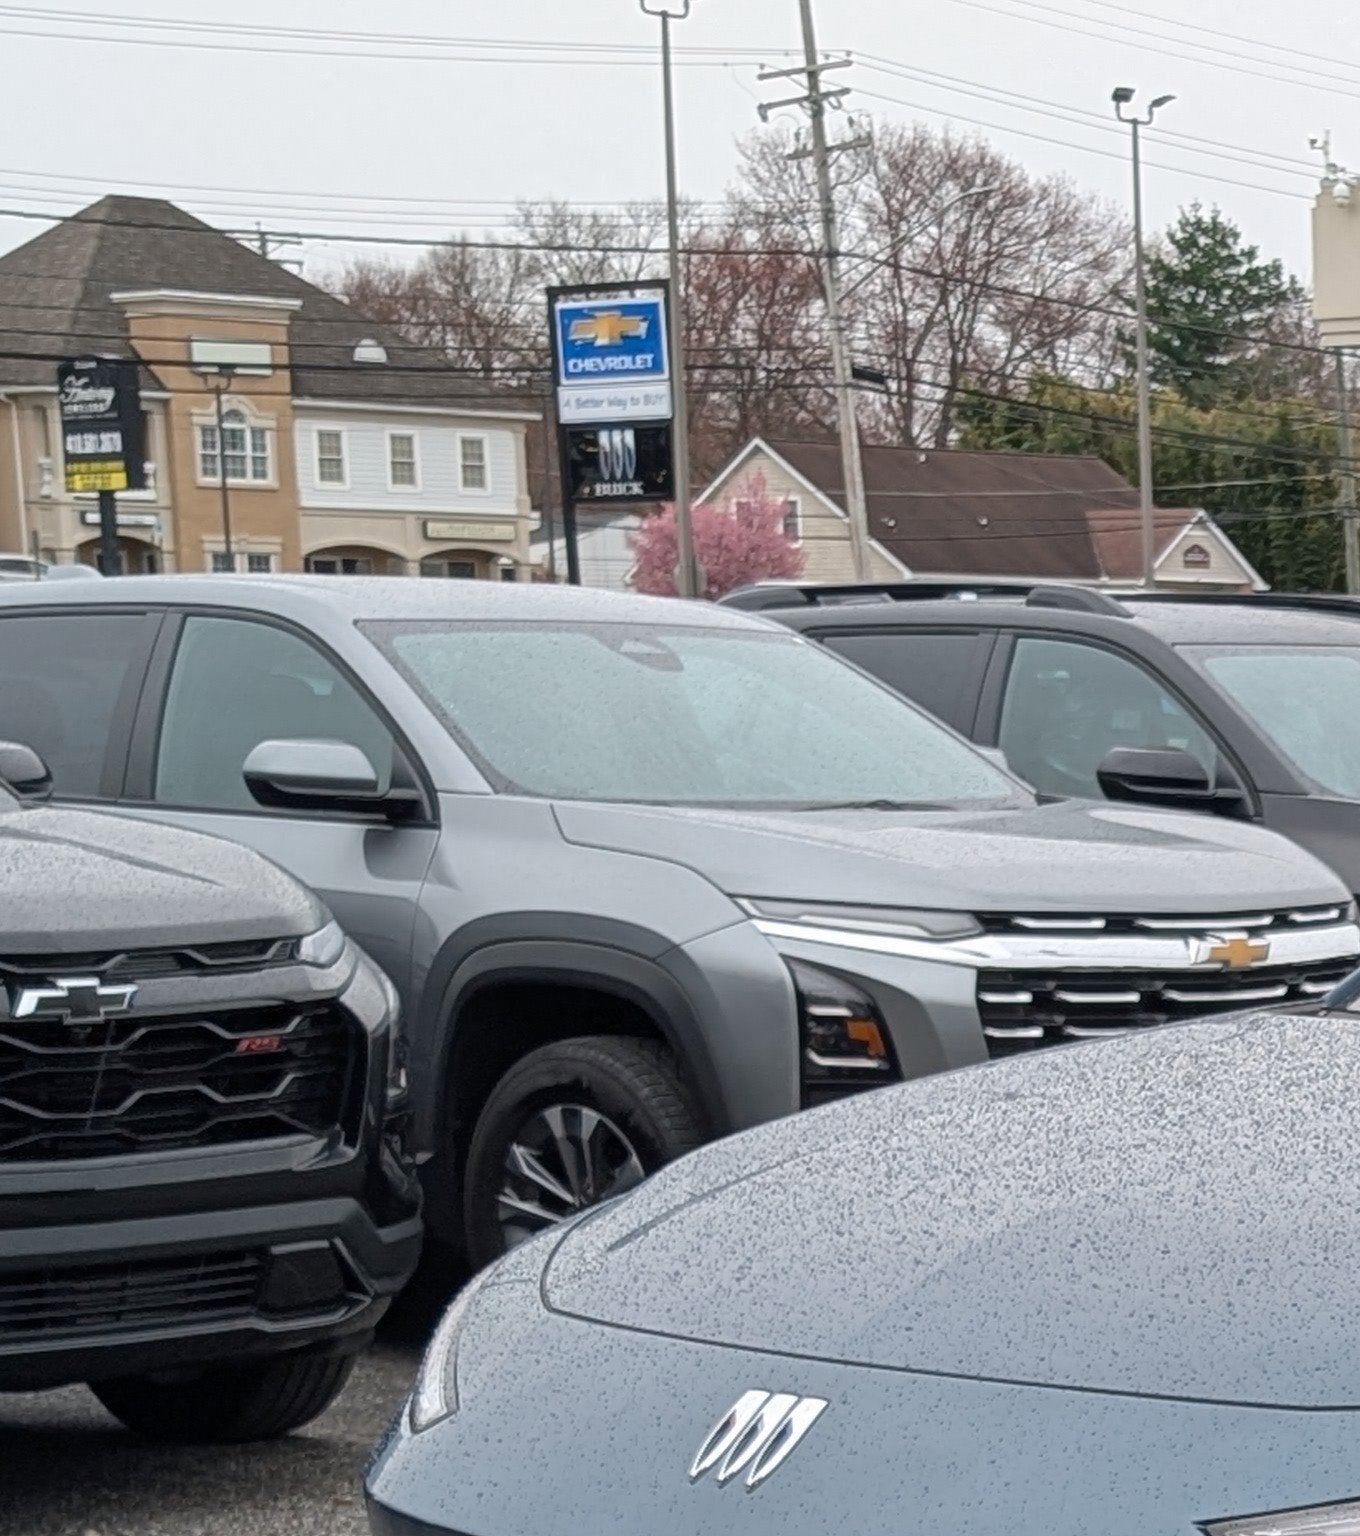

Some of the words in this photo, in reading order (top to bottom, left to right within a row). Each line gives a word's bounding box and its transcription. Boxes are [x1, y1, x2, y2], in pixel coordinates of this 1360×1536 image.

[567, 354, 654, 373] CHEVROLET
[575, 396, 604, 409] Better
[606, 396, 627, 410] Way
[629, 396, 640, 406] to
[595, 481, 644, 497] BUICK
